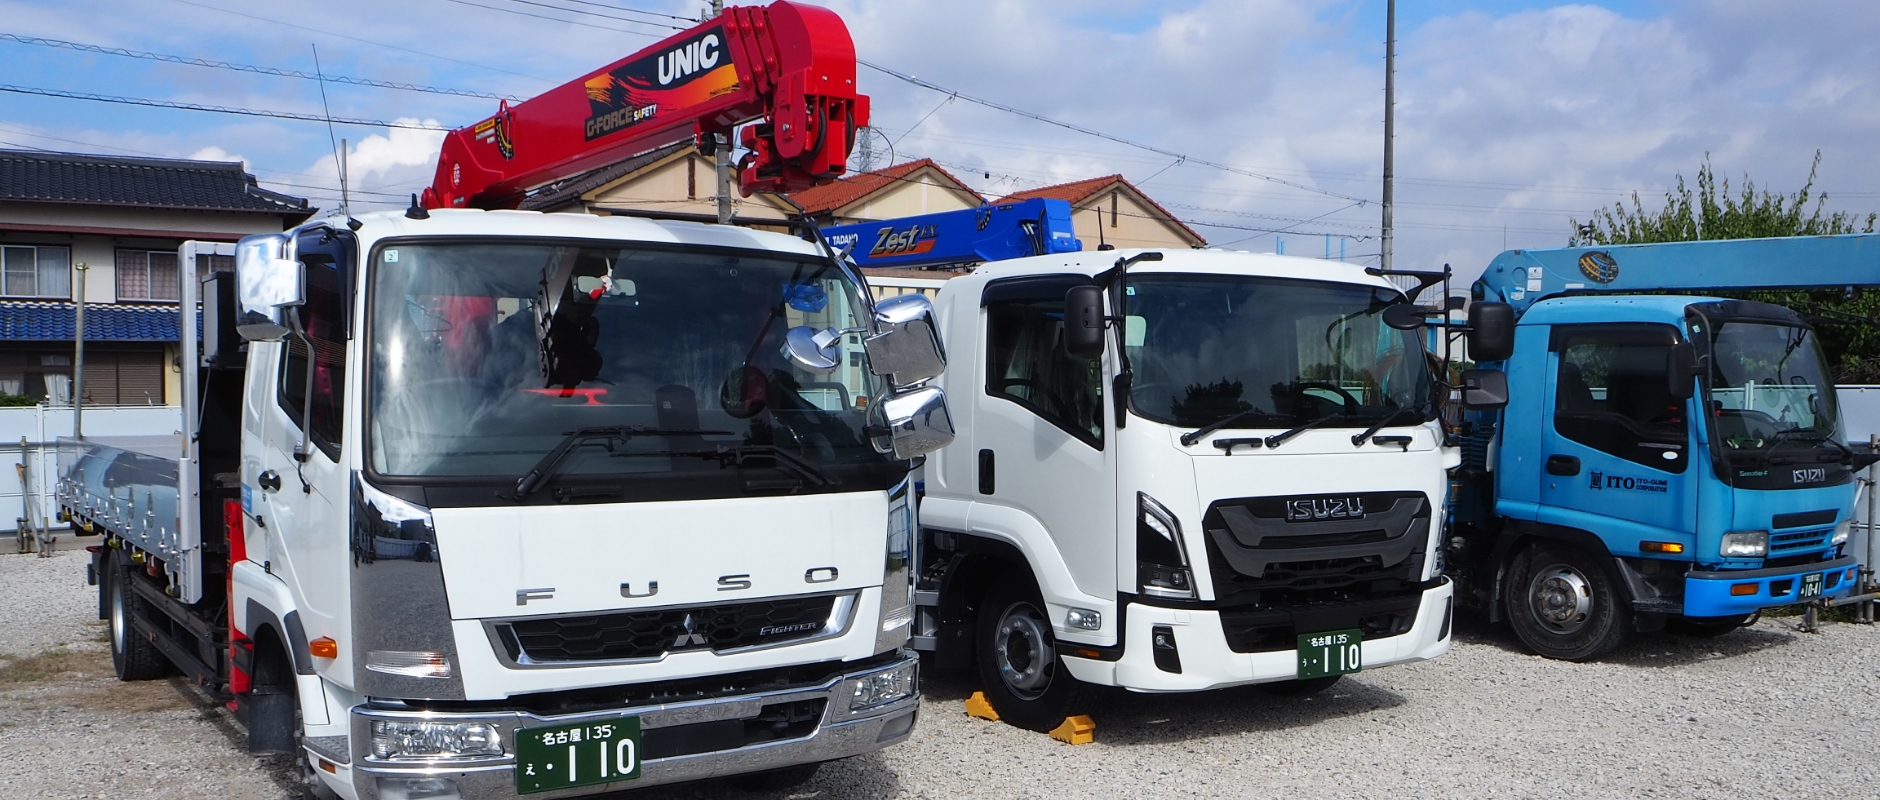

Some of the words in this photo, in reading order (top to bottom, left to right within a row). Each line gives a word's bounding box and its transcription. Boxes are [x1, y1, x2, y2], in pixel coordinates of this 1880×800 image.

[658, 34, 719, 85] UNIC
[586, 105, 633, 138] G-FORCE
[633, 103, 657, 121] SAFETY
[868, 224, 920, 255] Zest
[1606, 475, 1635, 490] ITO
[1793, 468, 1825, 483] ISUZU
[1287, 498, 1363, 520] ISUZU
[516, 566, 838, 605] FUSO
[1310, 635, 1332, 647] 名古屋
[1333, 633, 1348, 645] 135
[542, 728, 582, 746] 名古屋
[586, 724, 612, 740] 135
[525, 763, 536, 776] え
